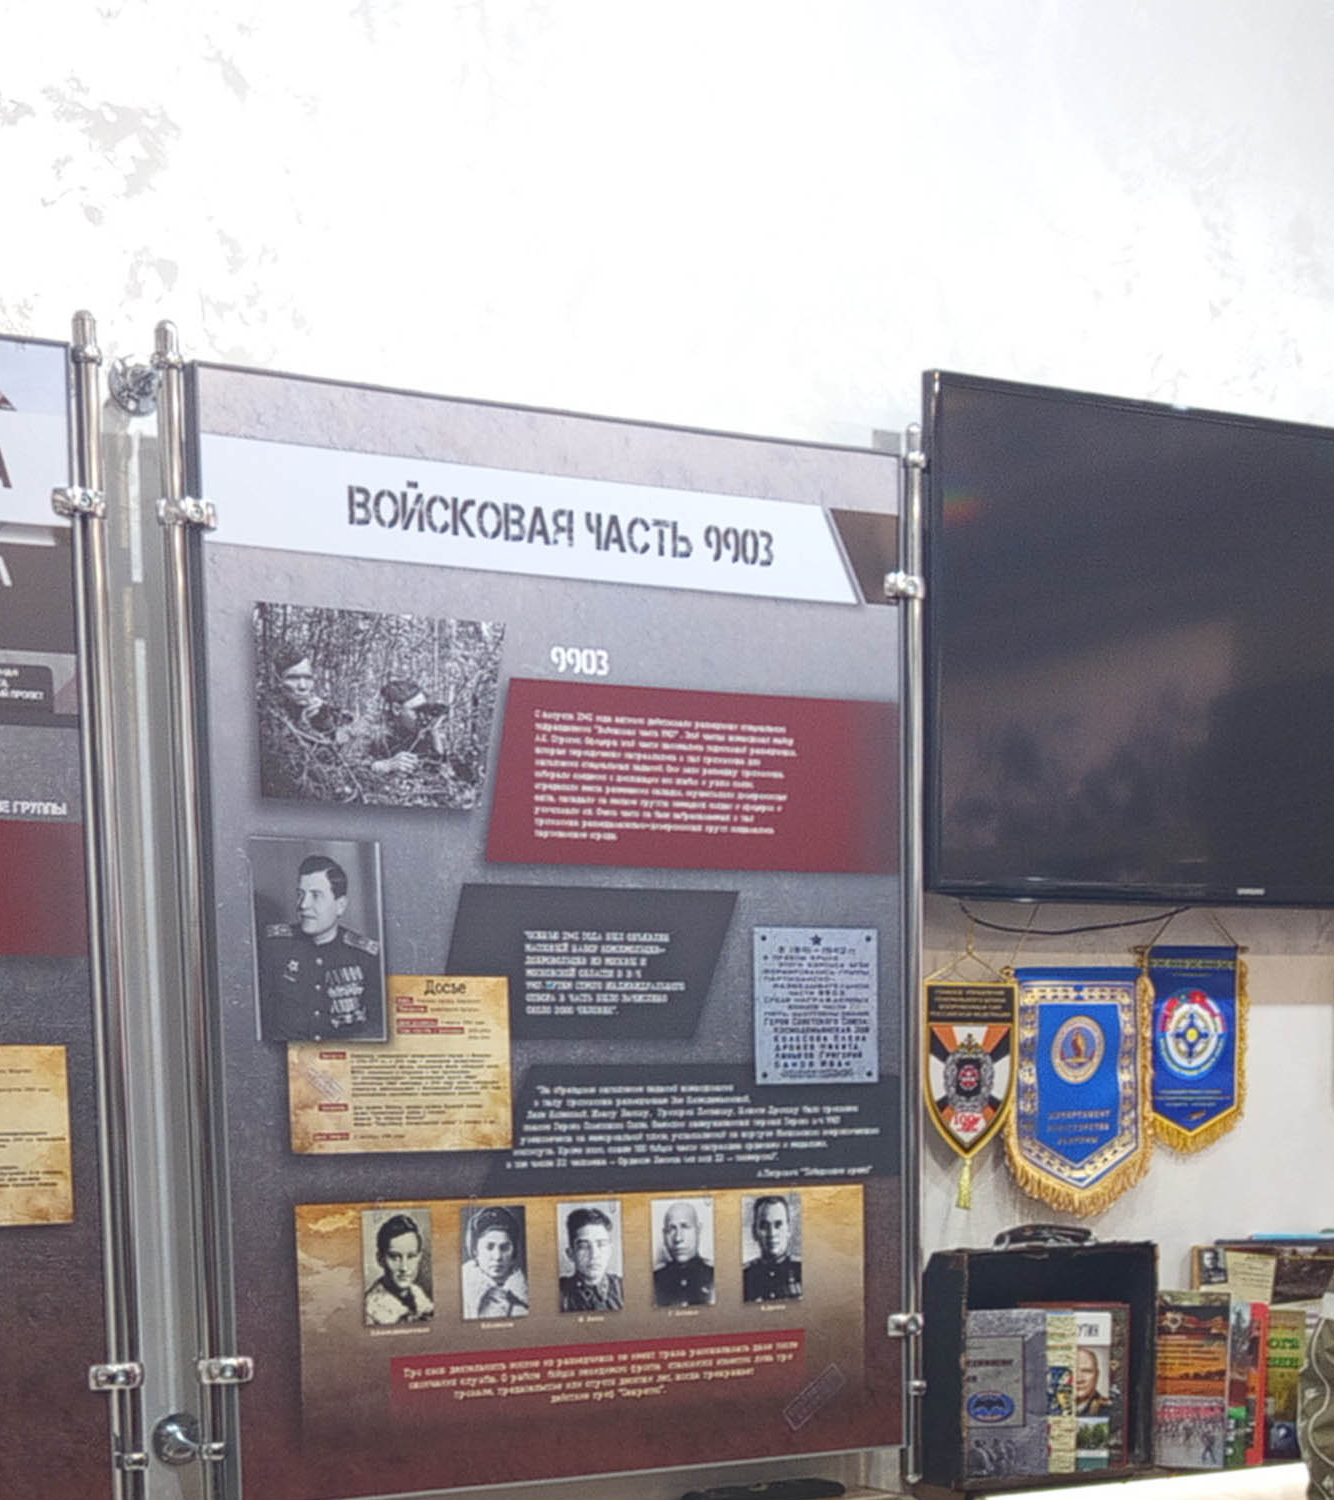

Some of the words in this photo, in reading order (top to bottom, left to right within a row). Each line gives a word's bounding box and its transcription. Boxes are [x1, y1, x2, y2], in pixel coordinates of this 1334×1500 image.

[346, 480, 573, 547] ВОЙСКОВАЯ
[586, 513, 693, 560] ЧАСТЬ
[704, 527, 774, 567] 9903
[550, 646, 610, 677] 9903
[423, 980, 467, 996] Досье
